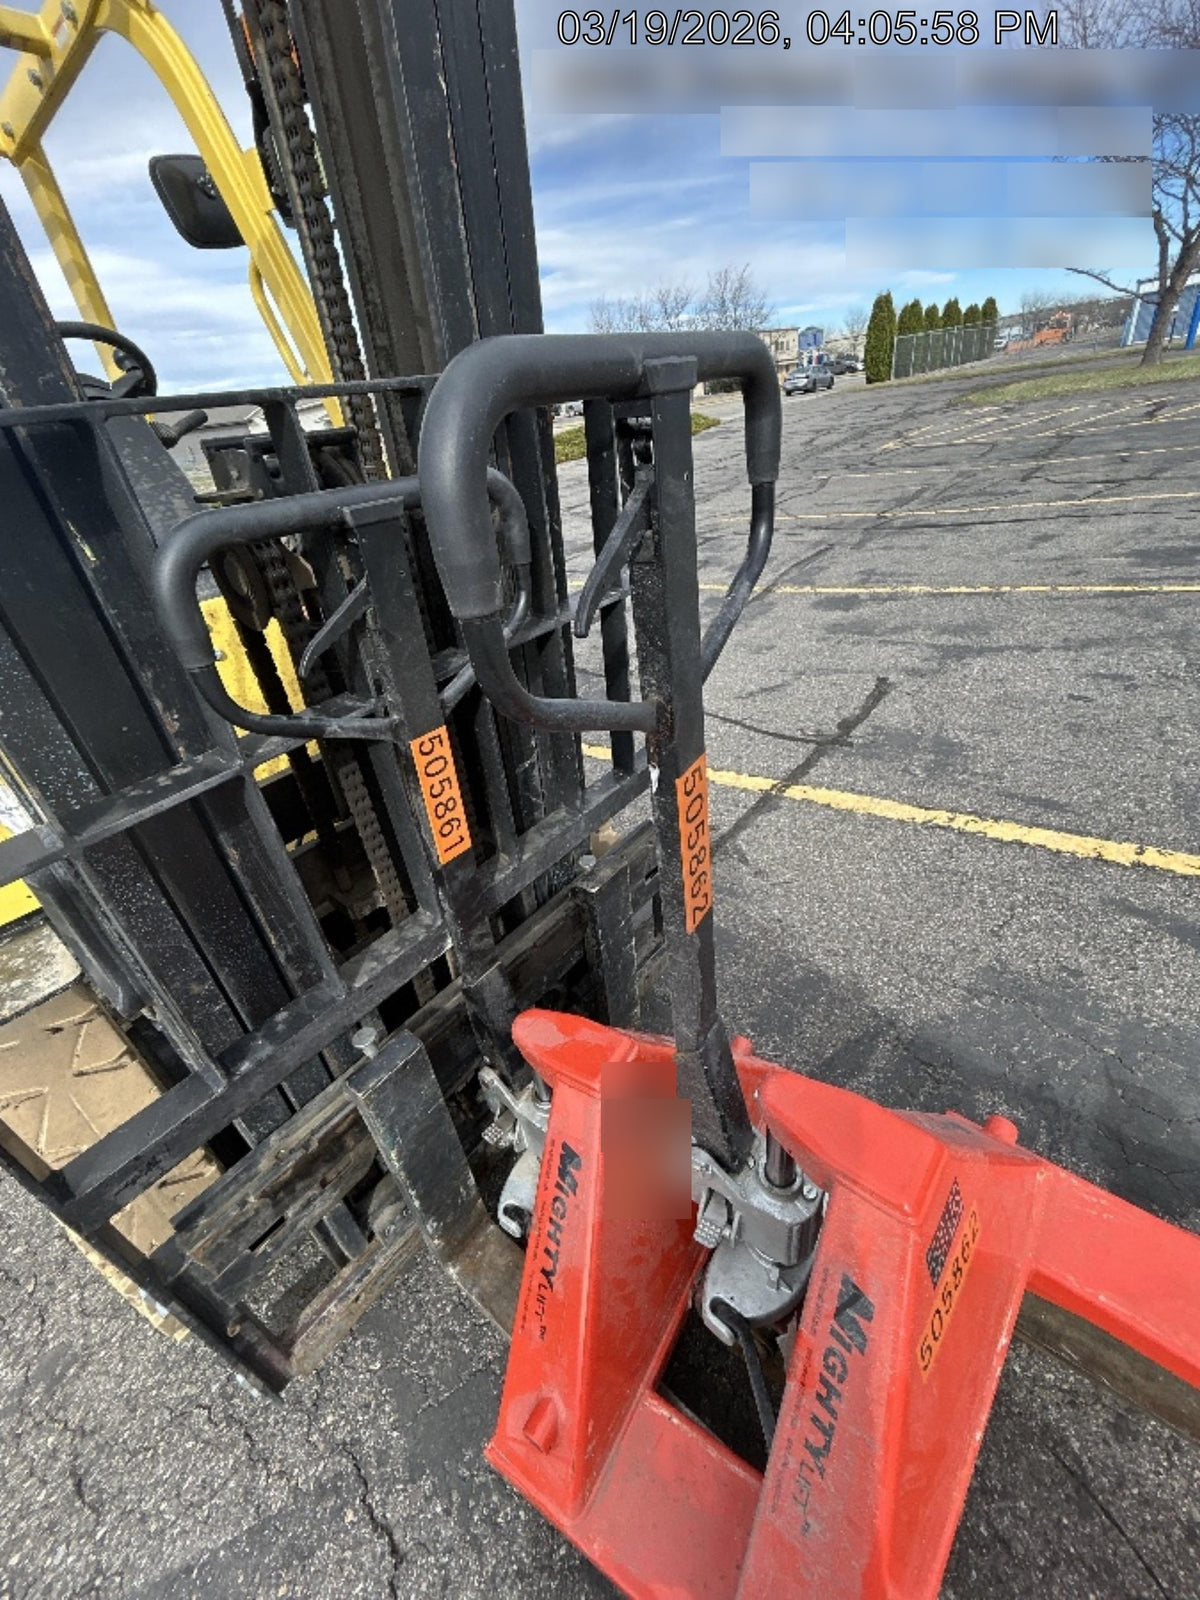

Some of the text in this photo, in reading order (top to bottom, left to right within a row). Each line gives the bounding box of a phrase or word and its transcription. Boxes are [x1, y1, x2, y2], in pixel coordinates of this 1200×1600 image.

[418, 733, 465, 853] 505861
[683, 765, 709, 925] 505862
[920, 1210, 980, 1372] 505862
